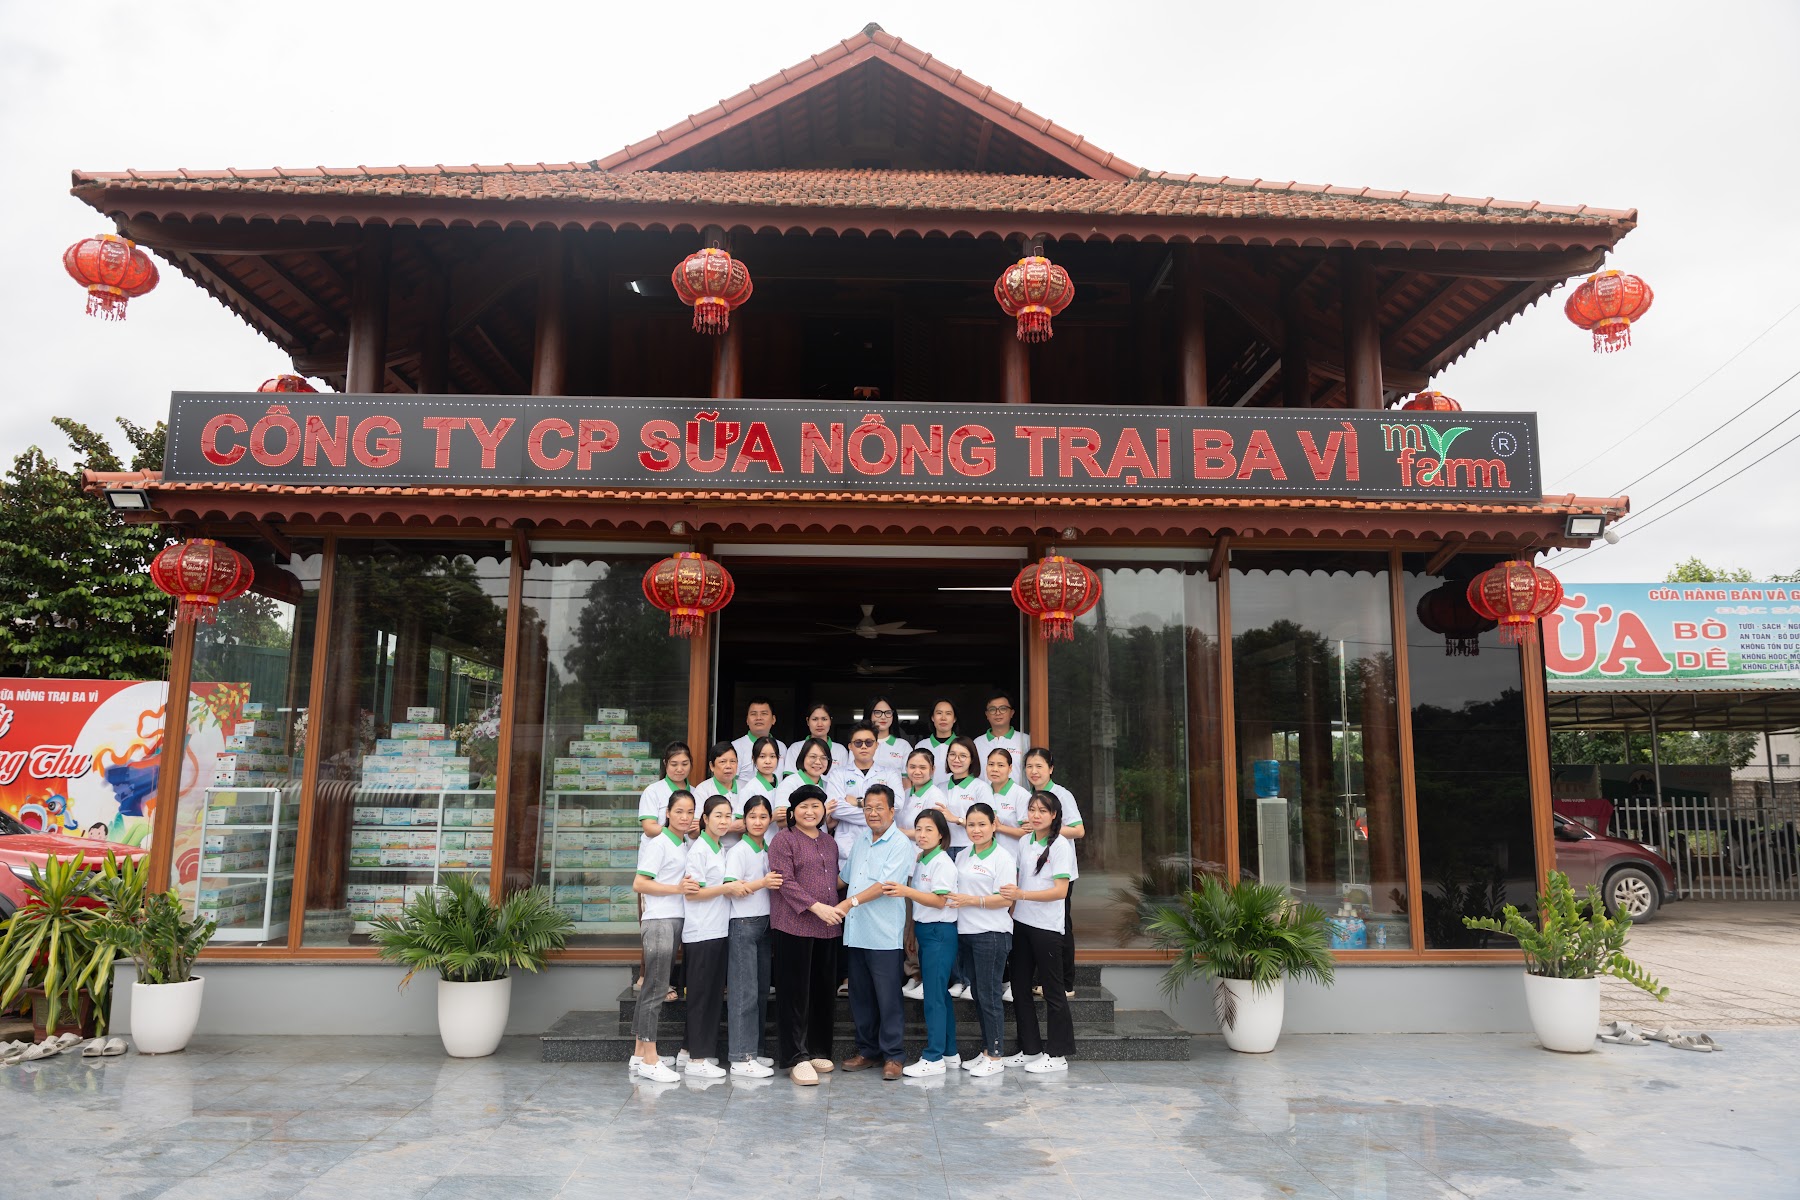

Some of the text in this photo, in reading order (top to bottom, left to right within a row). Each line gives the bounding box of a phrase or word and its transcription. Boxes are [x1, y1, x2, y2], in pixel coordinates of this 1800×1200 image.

[200, 404, 1360, 485] CÔNG TY CP SỮA NÔNG TRẠI BA VÌ
[1396, 447, 1512, 488] farm
[1649, 587, 1680, 601] CỬA
[1684, 588, 1726, 600] HÀNG
[1730, 588, 1763, 600] BÁN
[1766, 588, 1787, 600] VÀ
[1542, 594, 1672, 674] ỮA
[1674, 618, 1727, 640] BÒ
[1676, 647, 1728, 669] DÊ
[0, 688, 99, 704] ỮA NÔNG TRẠI BA VÌ
[29, 744, 92, 779] Thu
